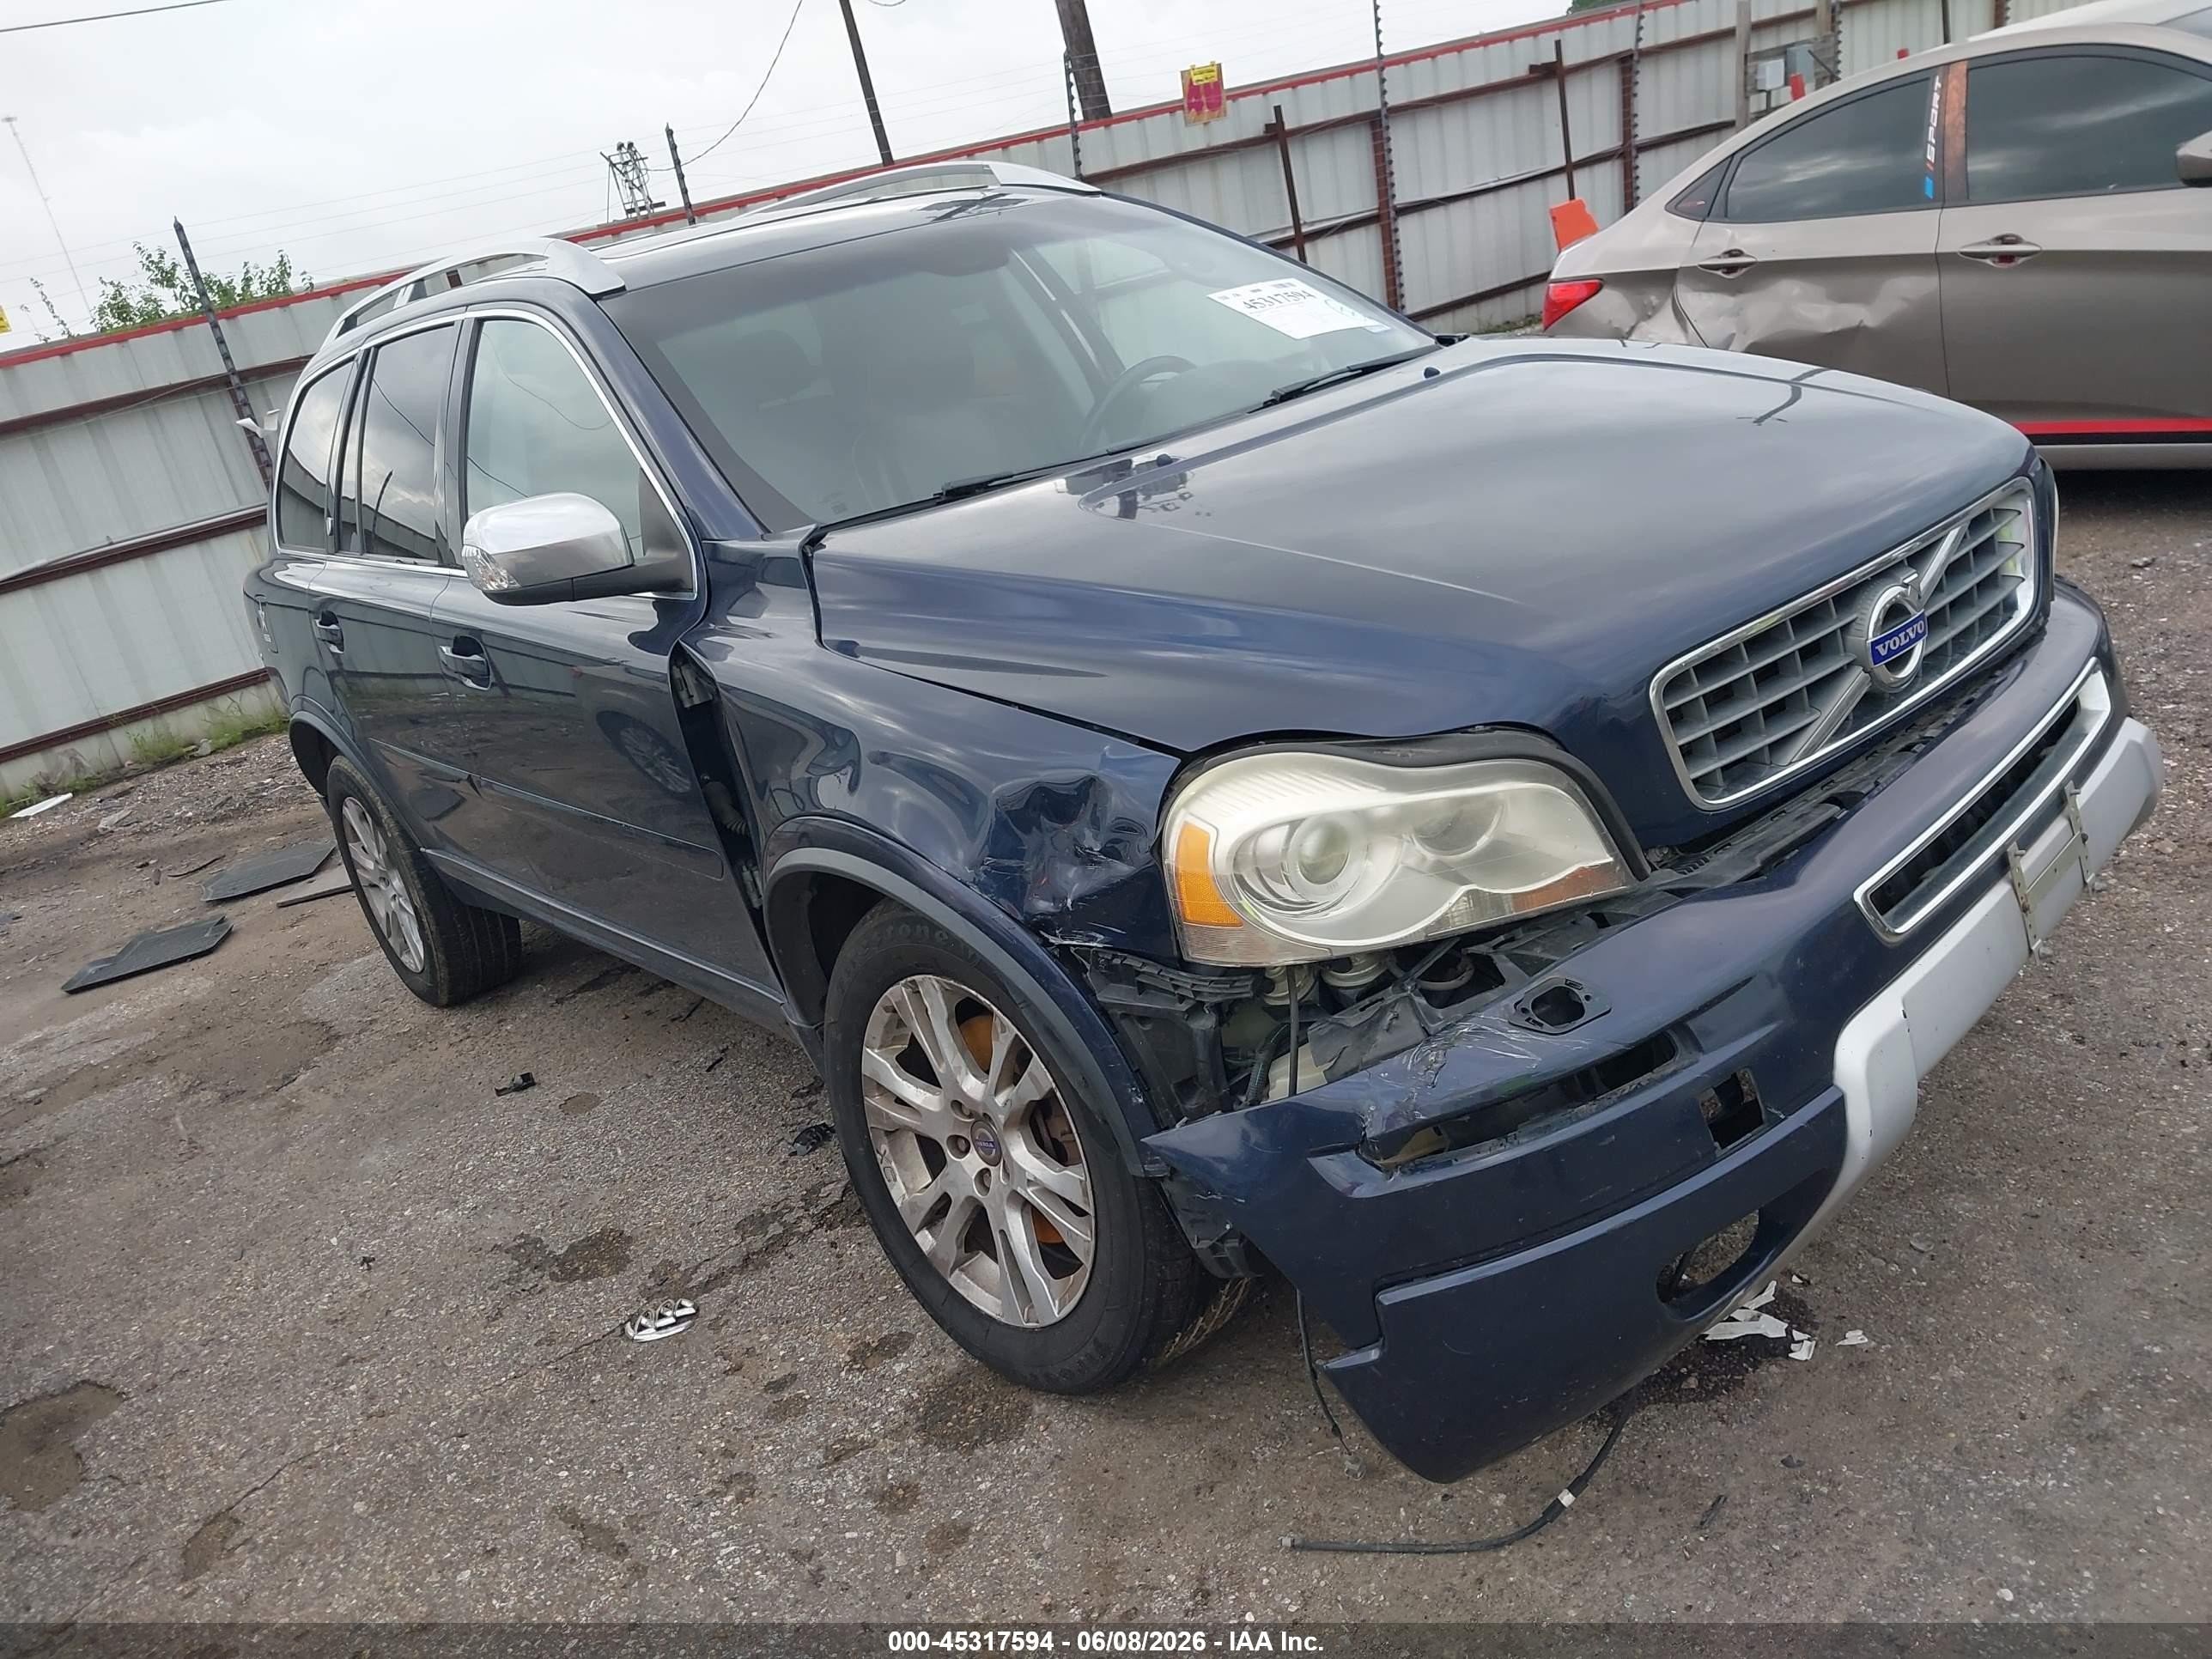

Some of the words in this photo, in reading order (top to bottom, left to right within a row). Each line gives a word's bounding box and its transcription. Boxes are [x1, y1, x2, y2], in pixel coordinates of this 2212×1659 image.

[1926, 75, 1942, 164] SPORT
[1243, 289, 1317, 310] 45317594
[1875, 620, 1924, 657] VOLVO
